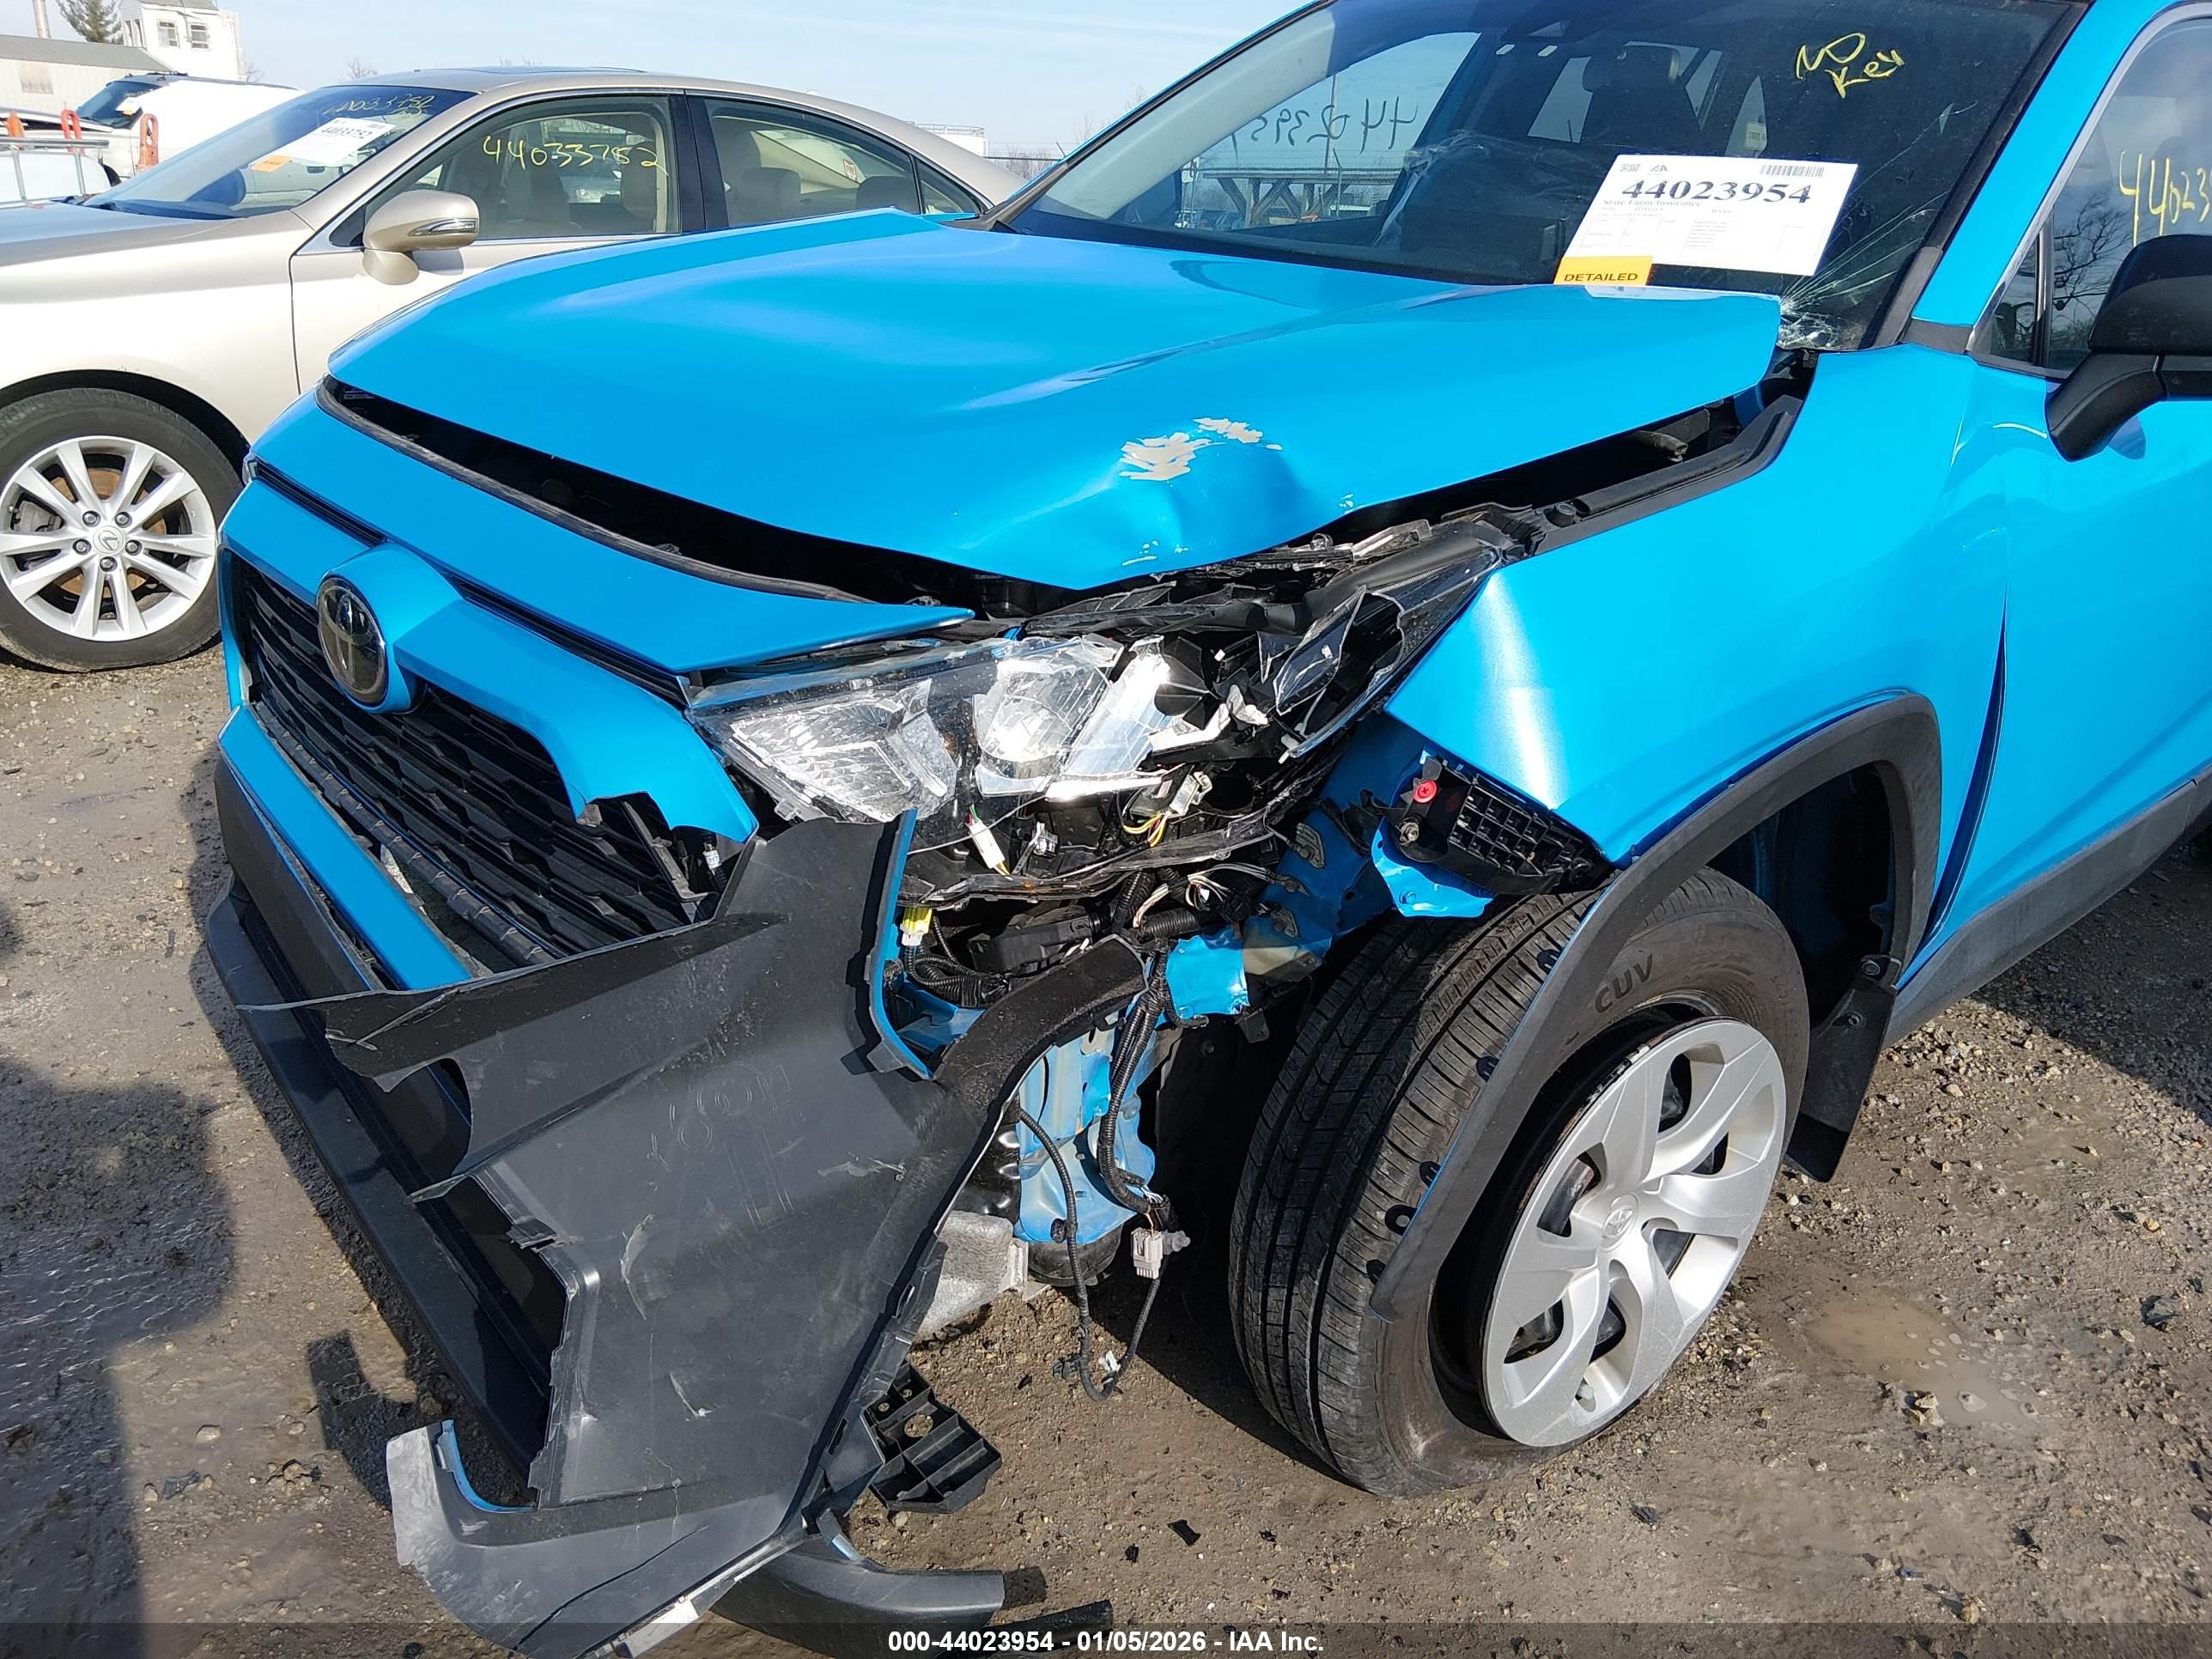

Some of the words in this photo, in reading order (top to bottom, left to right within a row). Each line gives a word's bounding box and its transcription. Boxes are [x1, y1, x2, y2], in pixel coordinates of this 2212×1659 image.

[1824, 49, 1905, 99] Key
[1622, 179, 1812, 204] 44023954
[2118, 150, 2212, 246] 44023
[1564, 273, 1638, 282] DETAILED
[1595, 953, 1653, 1013] CUV
